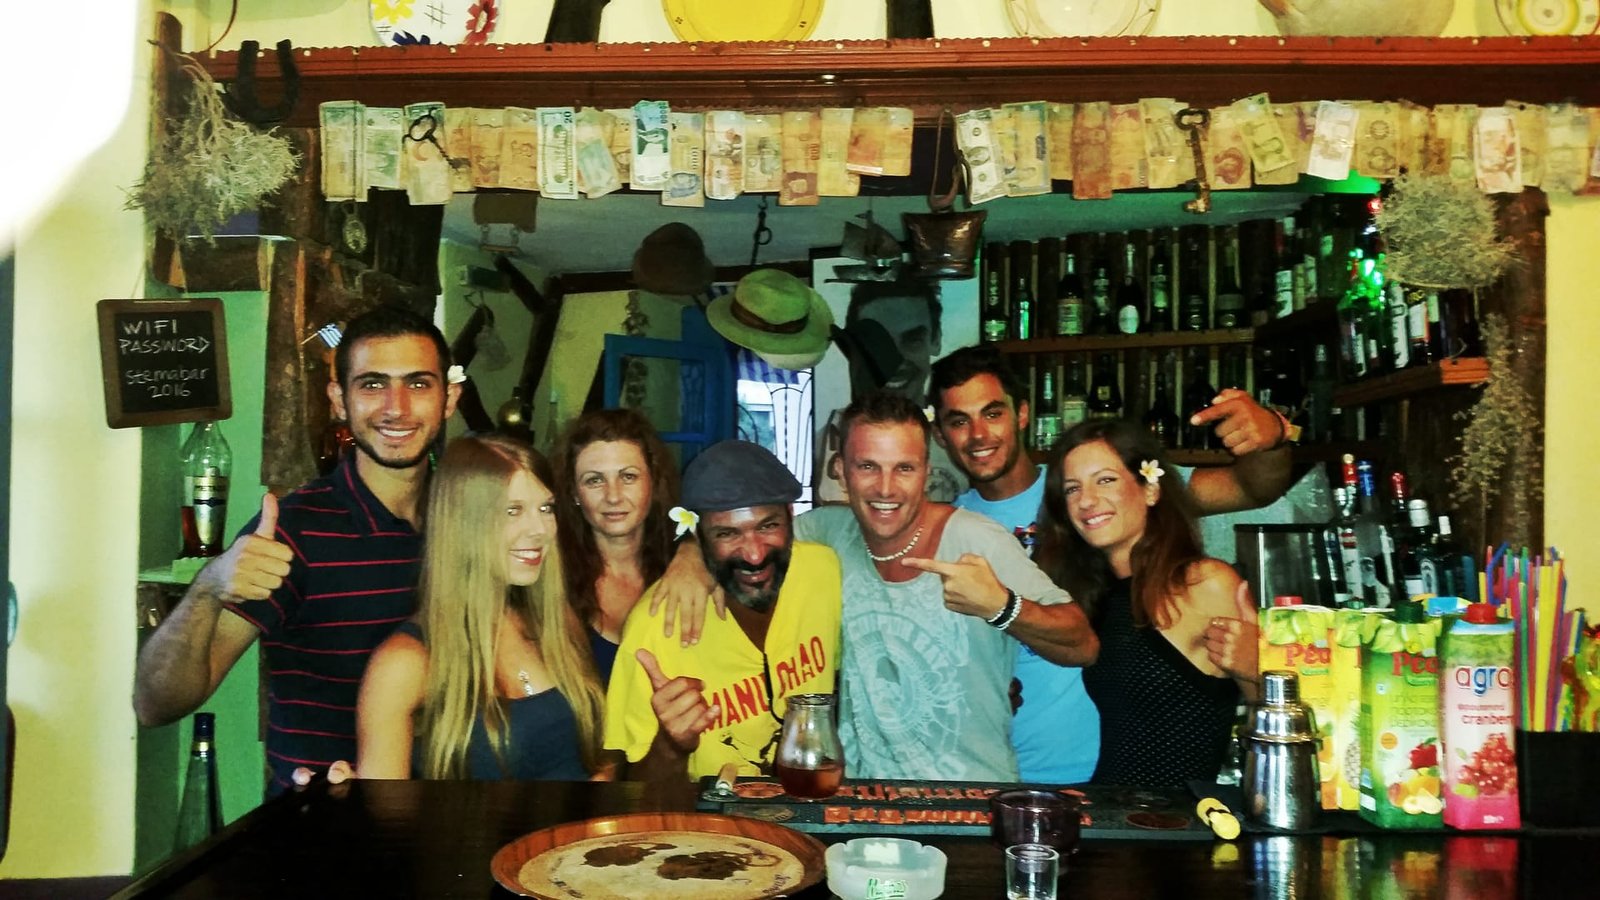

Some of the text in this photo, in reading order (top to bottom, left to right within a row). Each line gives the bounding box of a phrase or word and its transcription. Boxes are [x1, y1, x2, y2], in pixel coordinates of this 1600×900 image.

[121, 319, 178, 336] WIFI
[118, 336, 211, 355] PASSWORD
[146, 383, 192, 399] 2016
